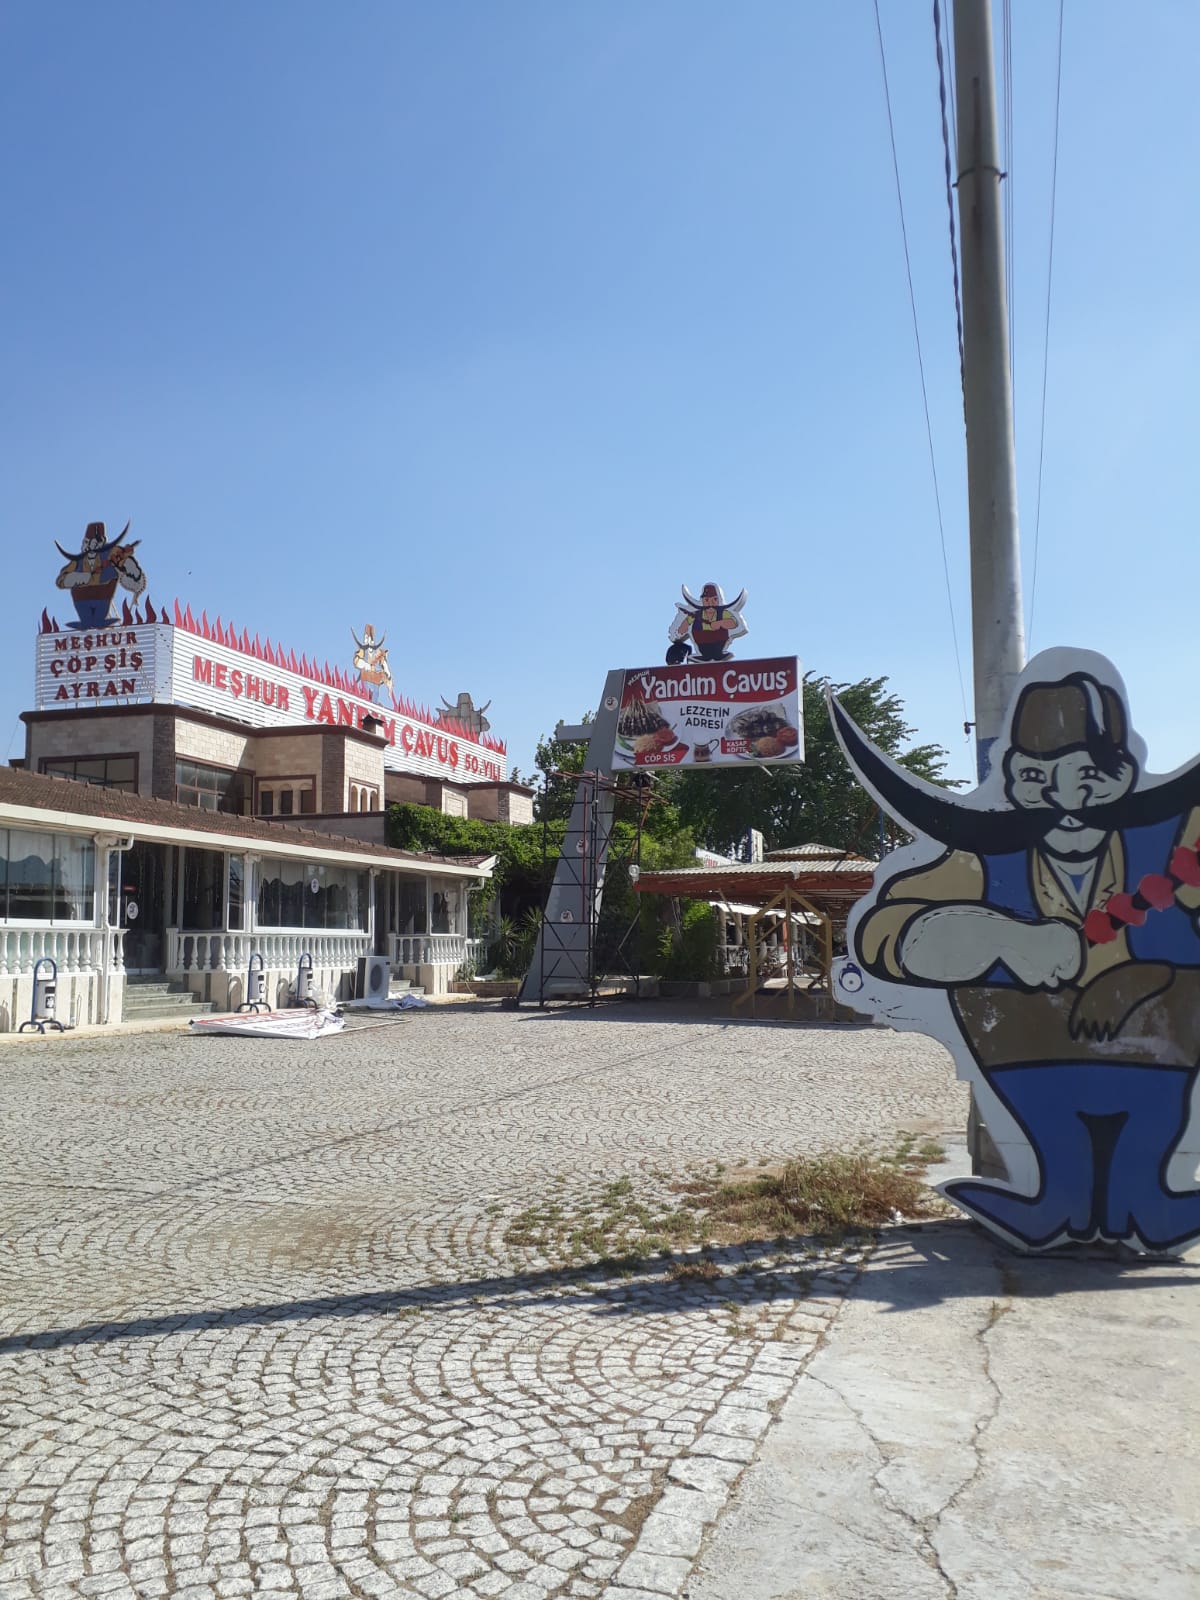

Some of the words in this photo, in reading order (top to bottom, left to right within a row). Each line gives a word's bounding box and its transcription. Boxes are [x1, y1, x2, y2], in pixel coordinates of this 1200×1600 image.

[54, 631, 138, 651] MEŞHUR
[50, 655, 98, 678] ÇÖP
[104, 648, 143, 673] ŞİŞ
[54, 678, 137, 700] AYRAN
[641, 671, 716, 699] Yandım
[722, 669, 788, 699] Çavuş
[192, 655, 290, 712] MEŞHUR
[401, 723, 459, 771] ÇAVUŞ
[680, 705, 730, 718] LEZZETİN
[685, 717, 724, 730] ADRESİ
